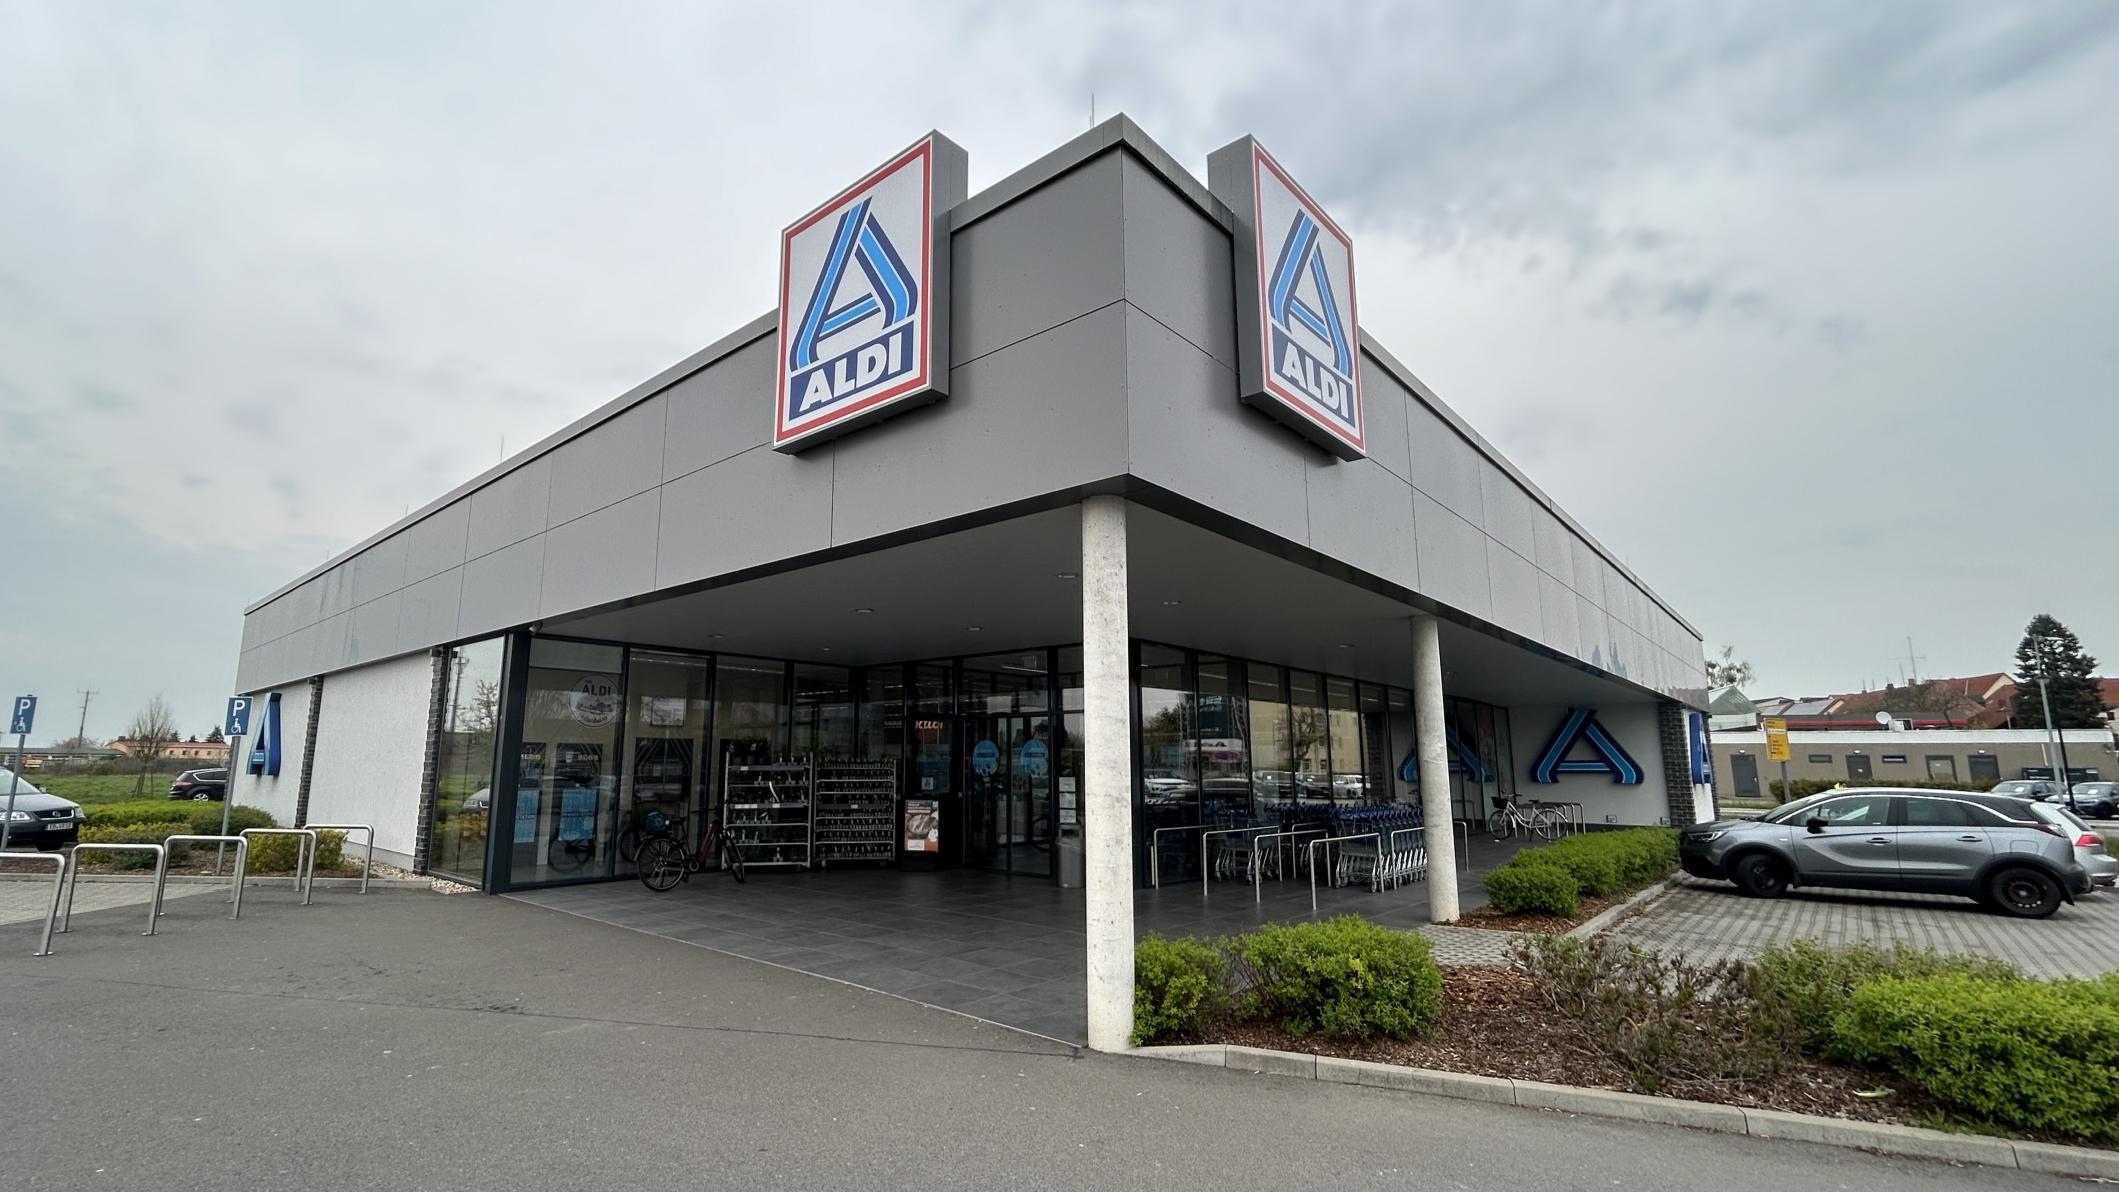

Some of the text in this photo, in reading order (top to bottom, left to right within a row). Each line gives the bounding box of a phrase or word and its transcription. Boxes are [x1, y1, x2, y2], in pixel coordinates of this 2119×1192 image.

[799, 332, 902, 412] ALDI
[1281, 342, 1349, 419] ALDI
[582, 684, 611, 696] ALDI
[18, 699, 31, 715] P
[233, 699, 246, 716] P
